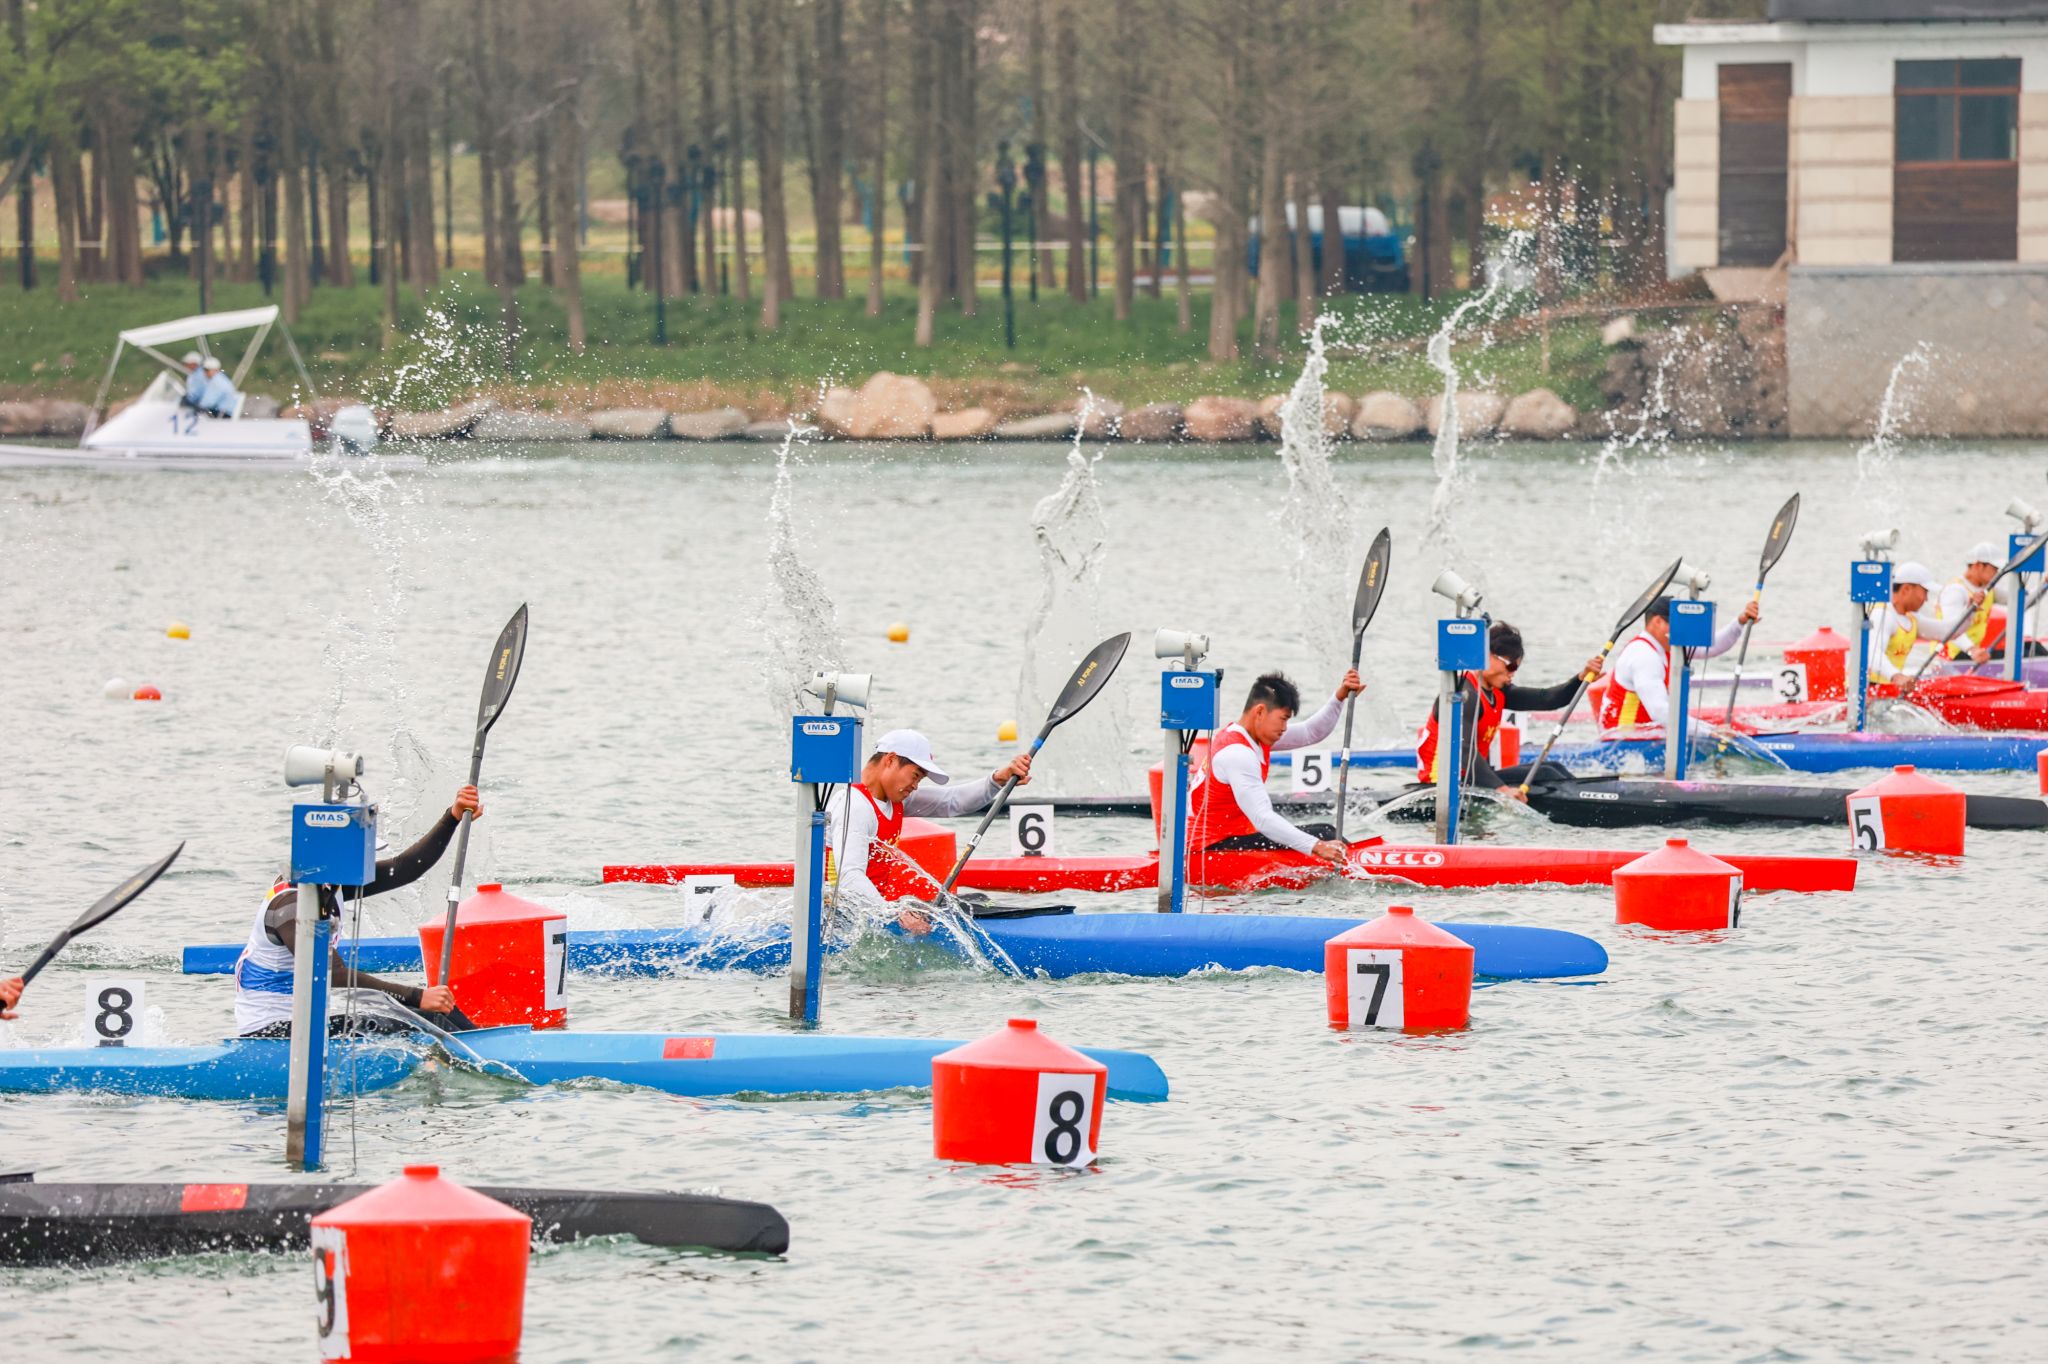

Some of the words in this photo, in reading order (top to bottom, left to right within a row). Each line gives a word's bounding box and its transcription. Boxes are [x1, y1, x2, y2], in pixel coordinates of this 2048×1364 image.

[168, 412, 198, 436] 12
[1780, 670, 1801, 697] 3
[1302, 755, 1322, 786] 5
[1580, 792, 1617, 800] NELO
[311, 813, 345, 821] IMAS
[1018, 813, 1046, 850] 6
[1854, 809, 1877, 851] 5
[1360, 851, 1442, 865] NELO
[552, 932, 567, 995] 7
[1357, 964, 1390, 1025] 7
[94, 987, 133, 1038] 8
[1044, 1090, 1085, 1165] 8
